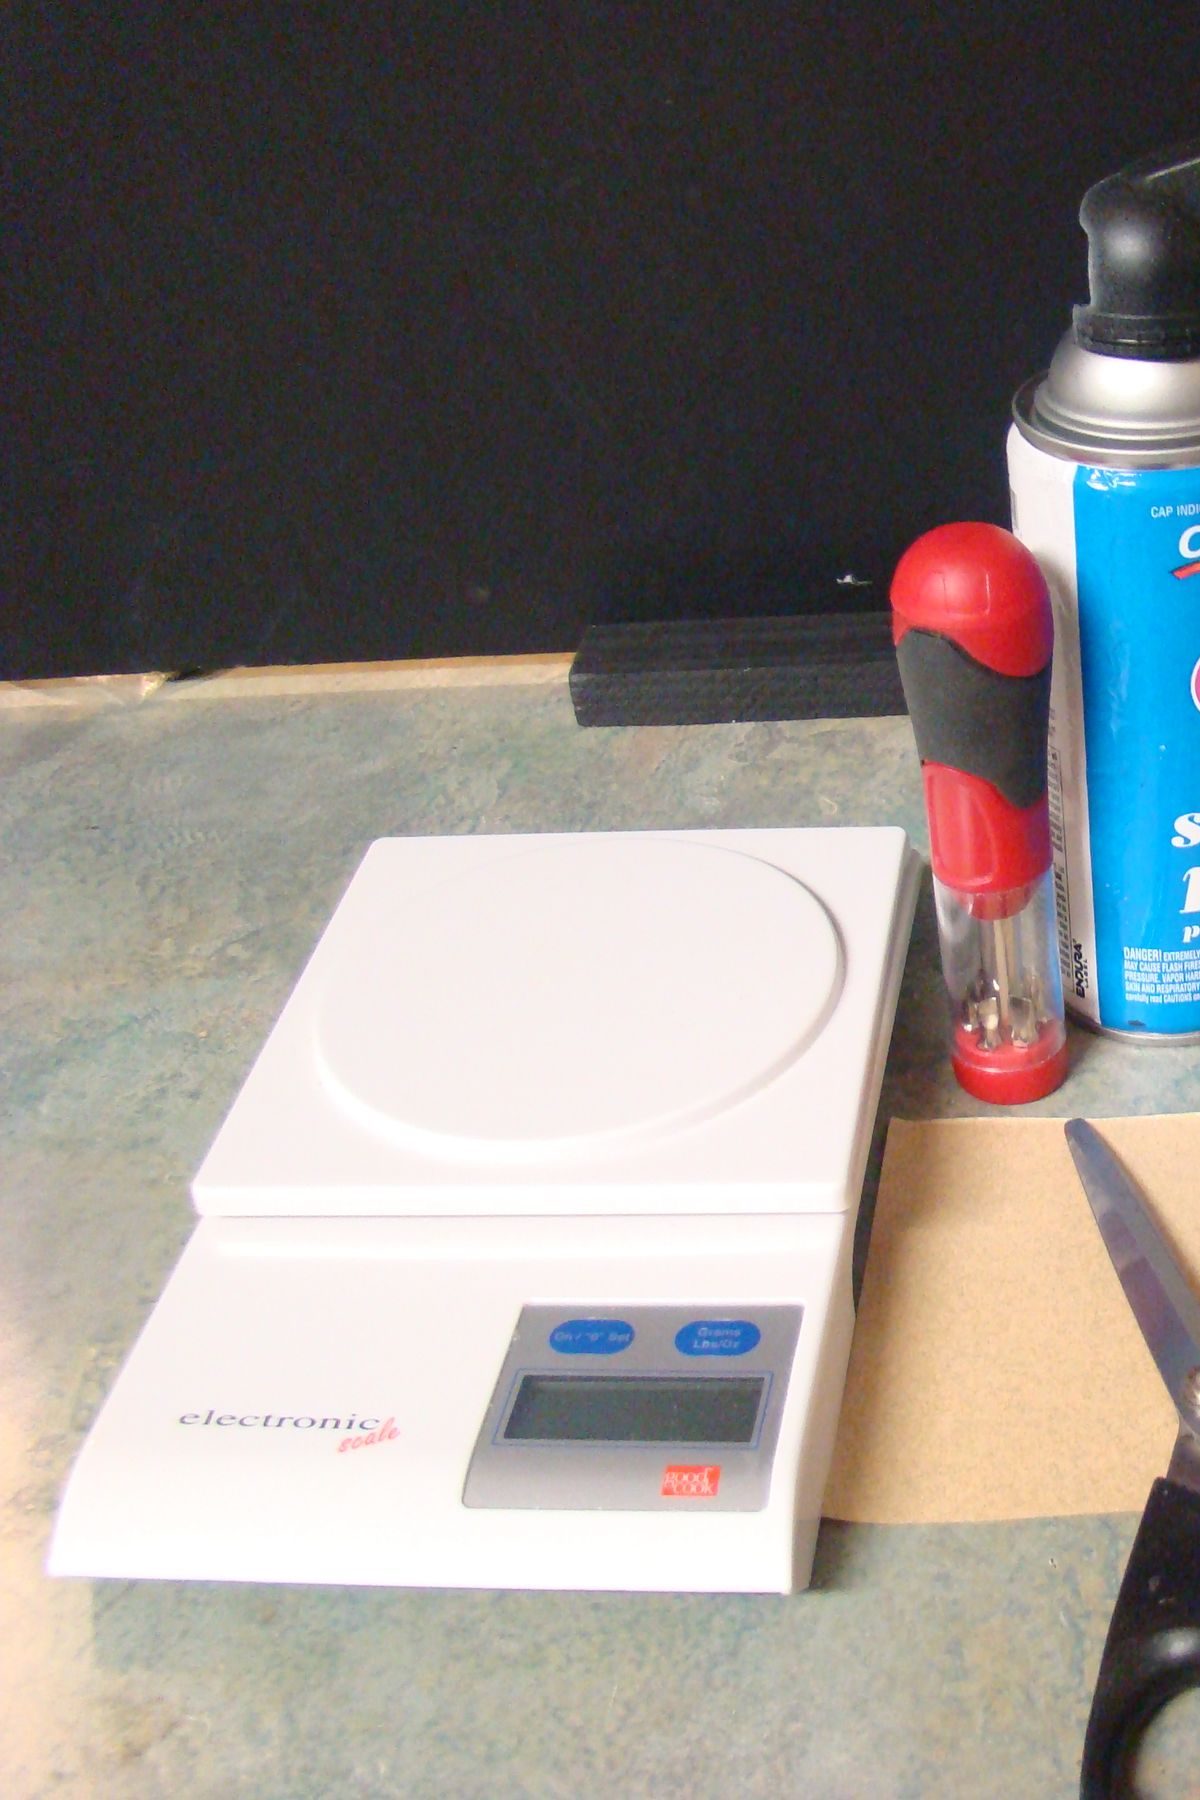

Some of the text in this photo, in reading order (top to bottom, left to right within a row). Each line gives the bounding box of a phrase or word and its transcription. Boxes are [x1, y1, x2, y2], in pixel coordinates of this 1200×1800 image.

[1150, 505, 1174, 518] CAP
[1123, 946, 1163, 962] DANGER!
[1073, 942, 1087, 999] ENDURA
[1123, 959, 1139, 971] MAY
[1139, 961, 1161, 974] CAUSE
[1161, 961, 1184, 973] FLASH
[1161, 972, 1185, 984] VAPOR
[1124, 981, 1141, 993] SKIN
[1141, 983, 1156, 994] AND
[1155, 981, 1200, 994] RESPIRATORY
[1149, 994, 1163, 1004] read
[1163, 992, 1193, 1004] CAUTIONS
[179, 1408, 381, 1432] electronic
[336, 1416, 401, 1453] scale
